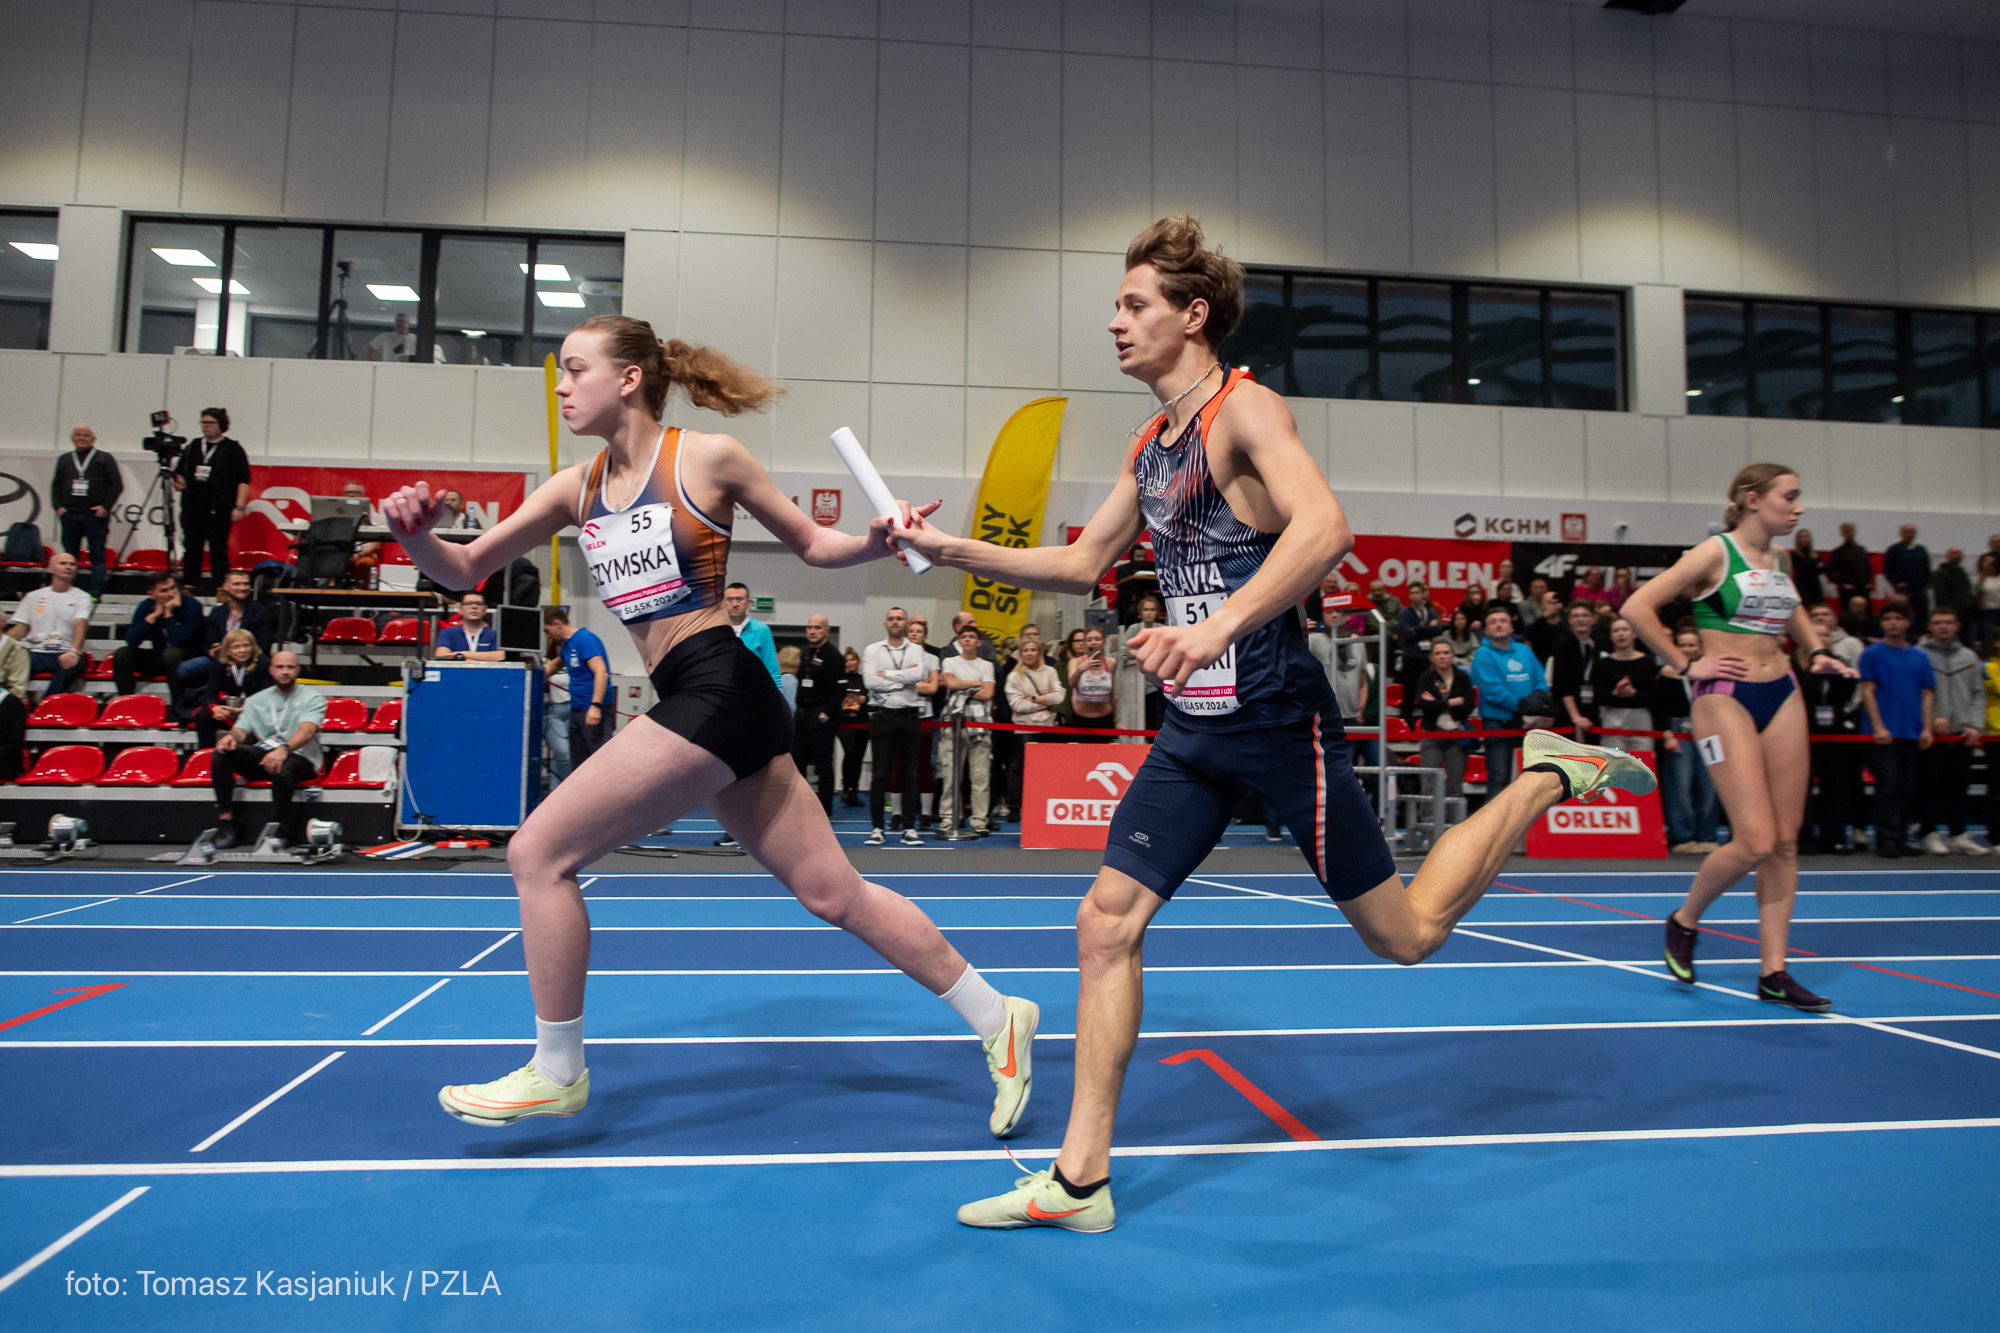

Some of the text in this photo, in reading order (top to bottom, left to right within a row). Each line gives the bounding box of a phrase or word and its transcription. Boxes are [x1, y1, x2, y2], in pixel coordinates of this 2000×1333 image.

[630, 511, 652, 534] 55
[1485, 517, 1550, 535] KGHM
[969, 502, 1006, 611] DNY
[991, 514, 1033, 616] ŚLSK
[1534, 554, 1579, 578] 4F
[1378, 558, 1493, 591] ORLEN
[654, 593, 679, 607] 2024
[1185, 601, 1209, 625] 51
[1184, 699, 1206, 713] ŚLĄSK
[1206, 701, 1228, 711] 2024
[1703, 740, 1717, 761] 1
[1052, 802, 1118, 822] ORLE
[1554, 811, 1632, 829] ORLEN
